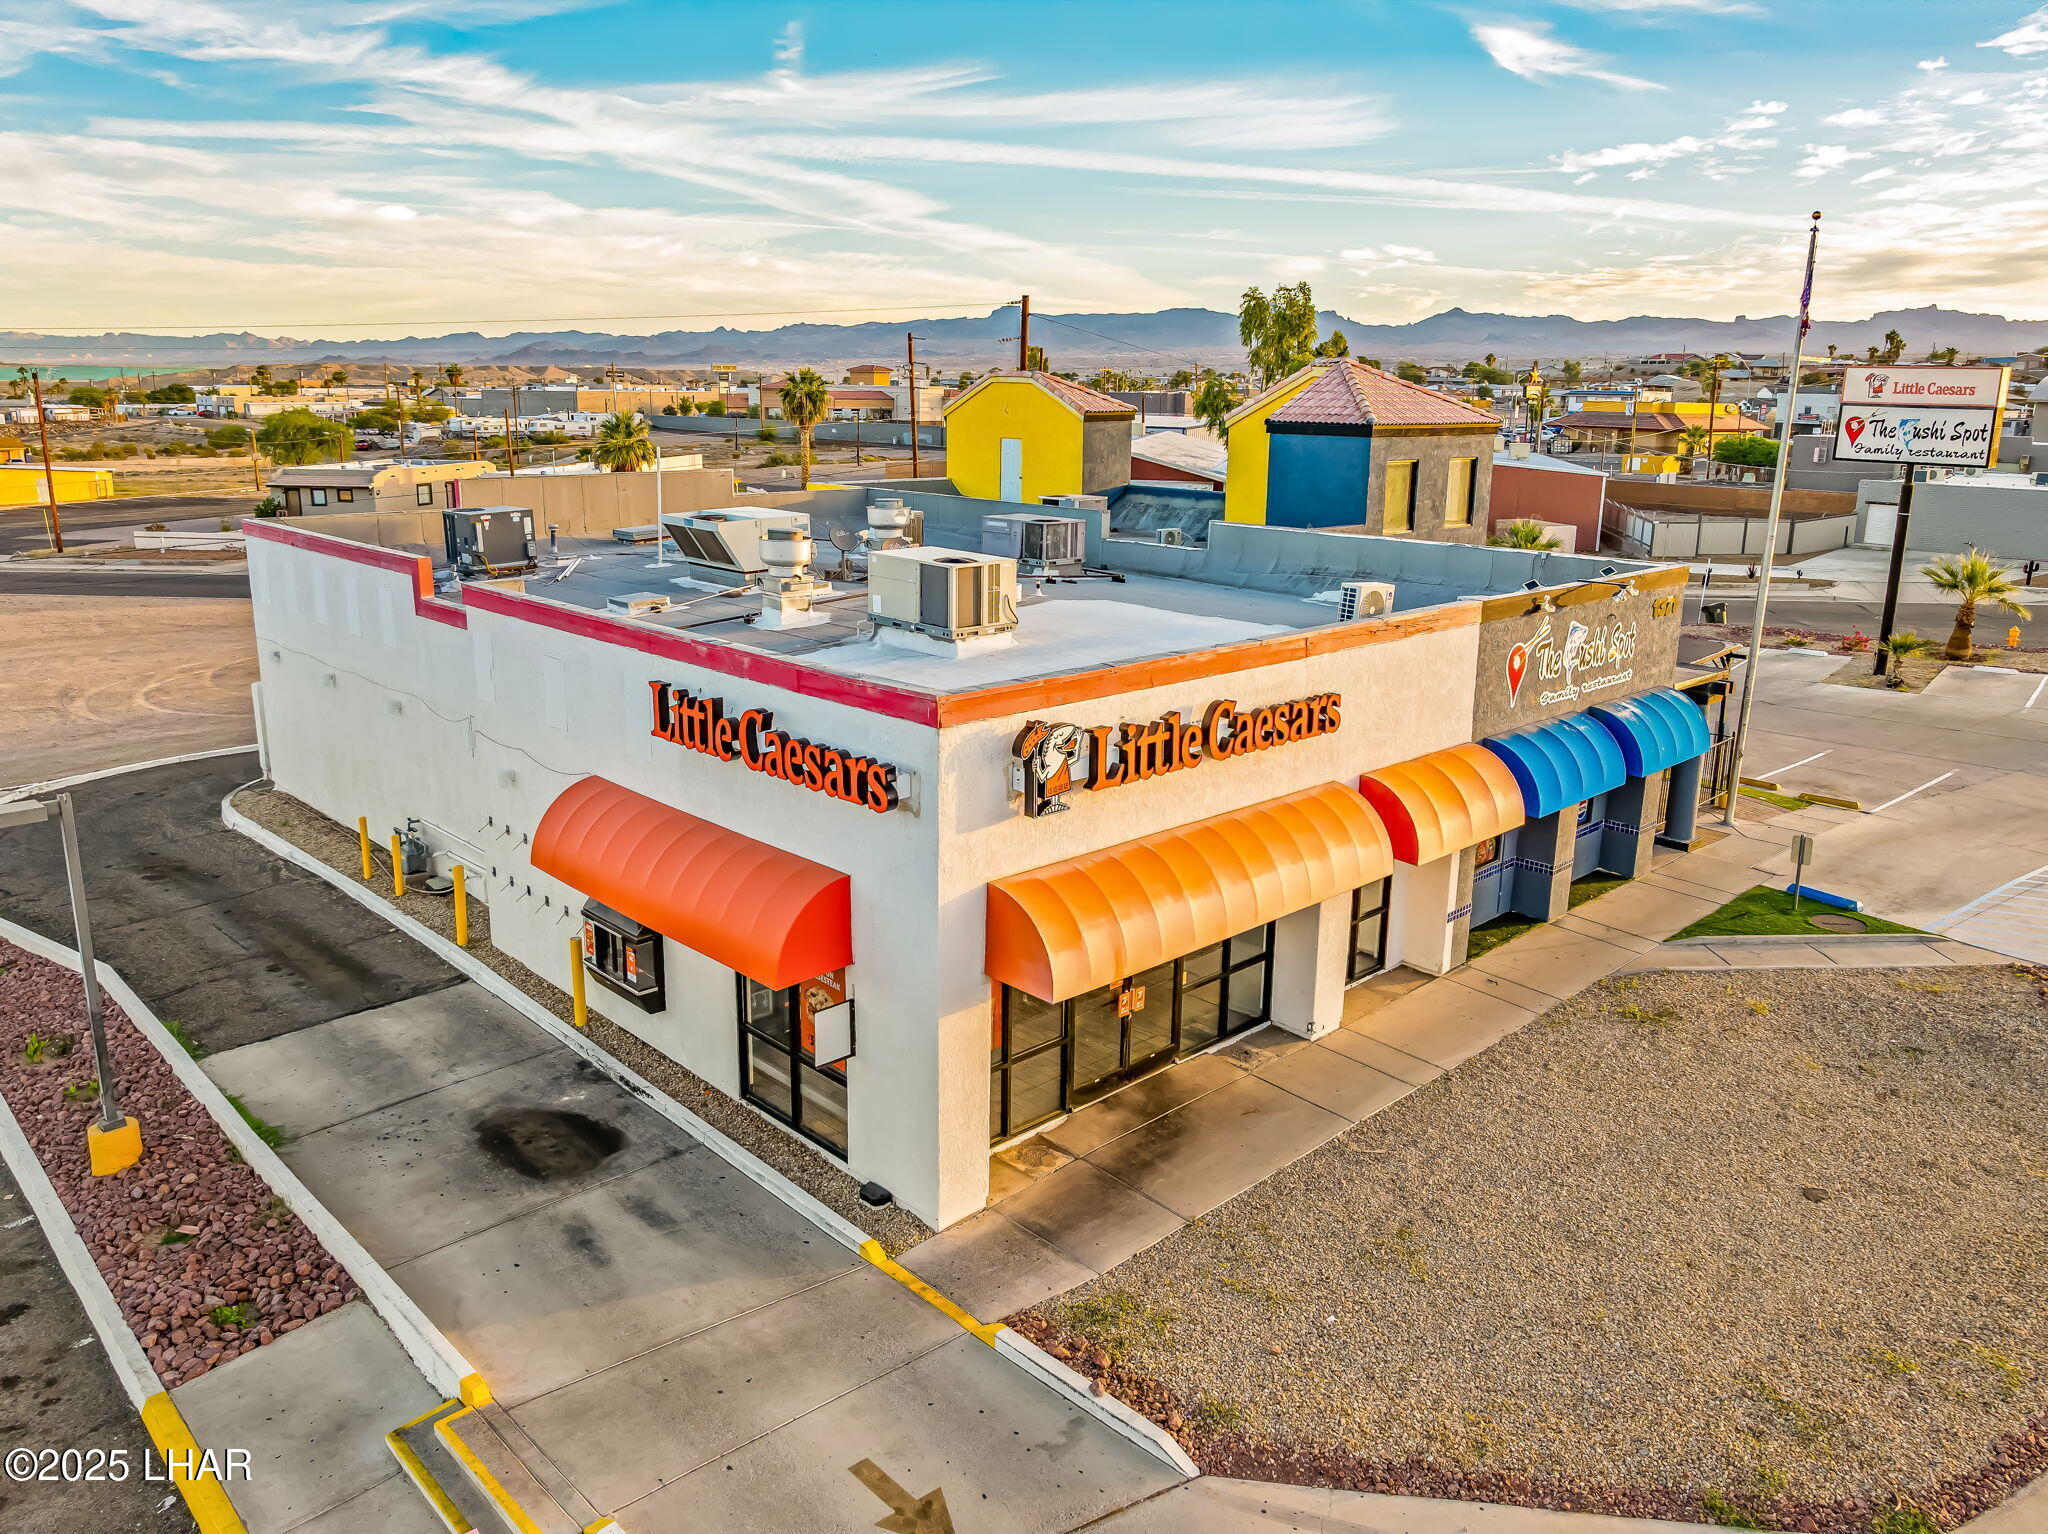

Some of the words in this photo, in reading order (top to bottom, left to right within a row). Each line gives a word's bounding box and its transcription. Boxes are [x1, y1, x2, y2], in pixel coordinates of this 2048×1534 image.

[1892, 381, 1925, 395] Little
[1927, 382, 1976, 396] Caesars
[1854, 442, 1904, 460] Family
[1908, 448, 1987, 460] restaurant
[1869, 418, 1897, 439] The
[1950, 421, 1989, 447] Spot
[1536, 637, 1563, 681] The
[1607, 621, 1637, 670] Spot
[1540, 684, 1580, 706] Family
[1581, 668, 1633, 693] restaurant
[648, 680, 742, 762] Little
[738, 707, 899, 814] Caesars
[1083, 710, 1203, 791] Little
[1201, 692, 1342, 761] Caesars
